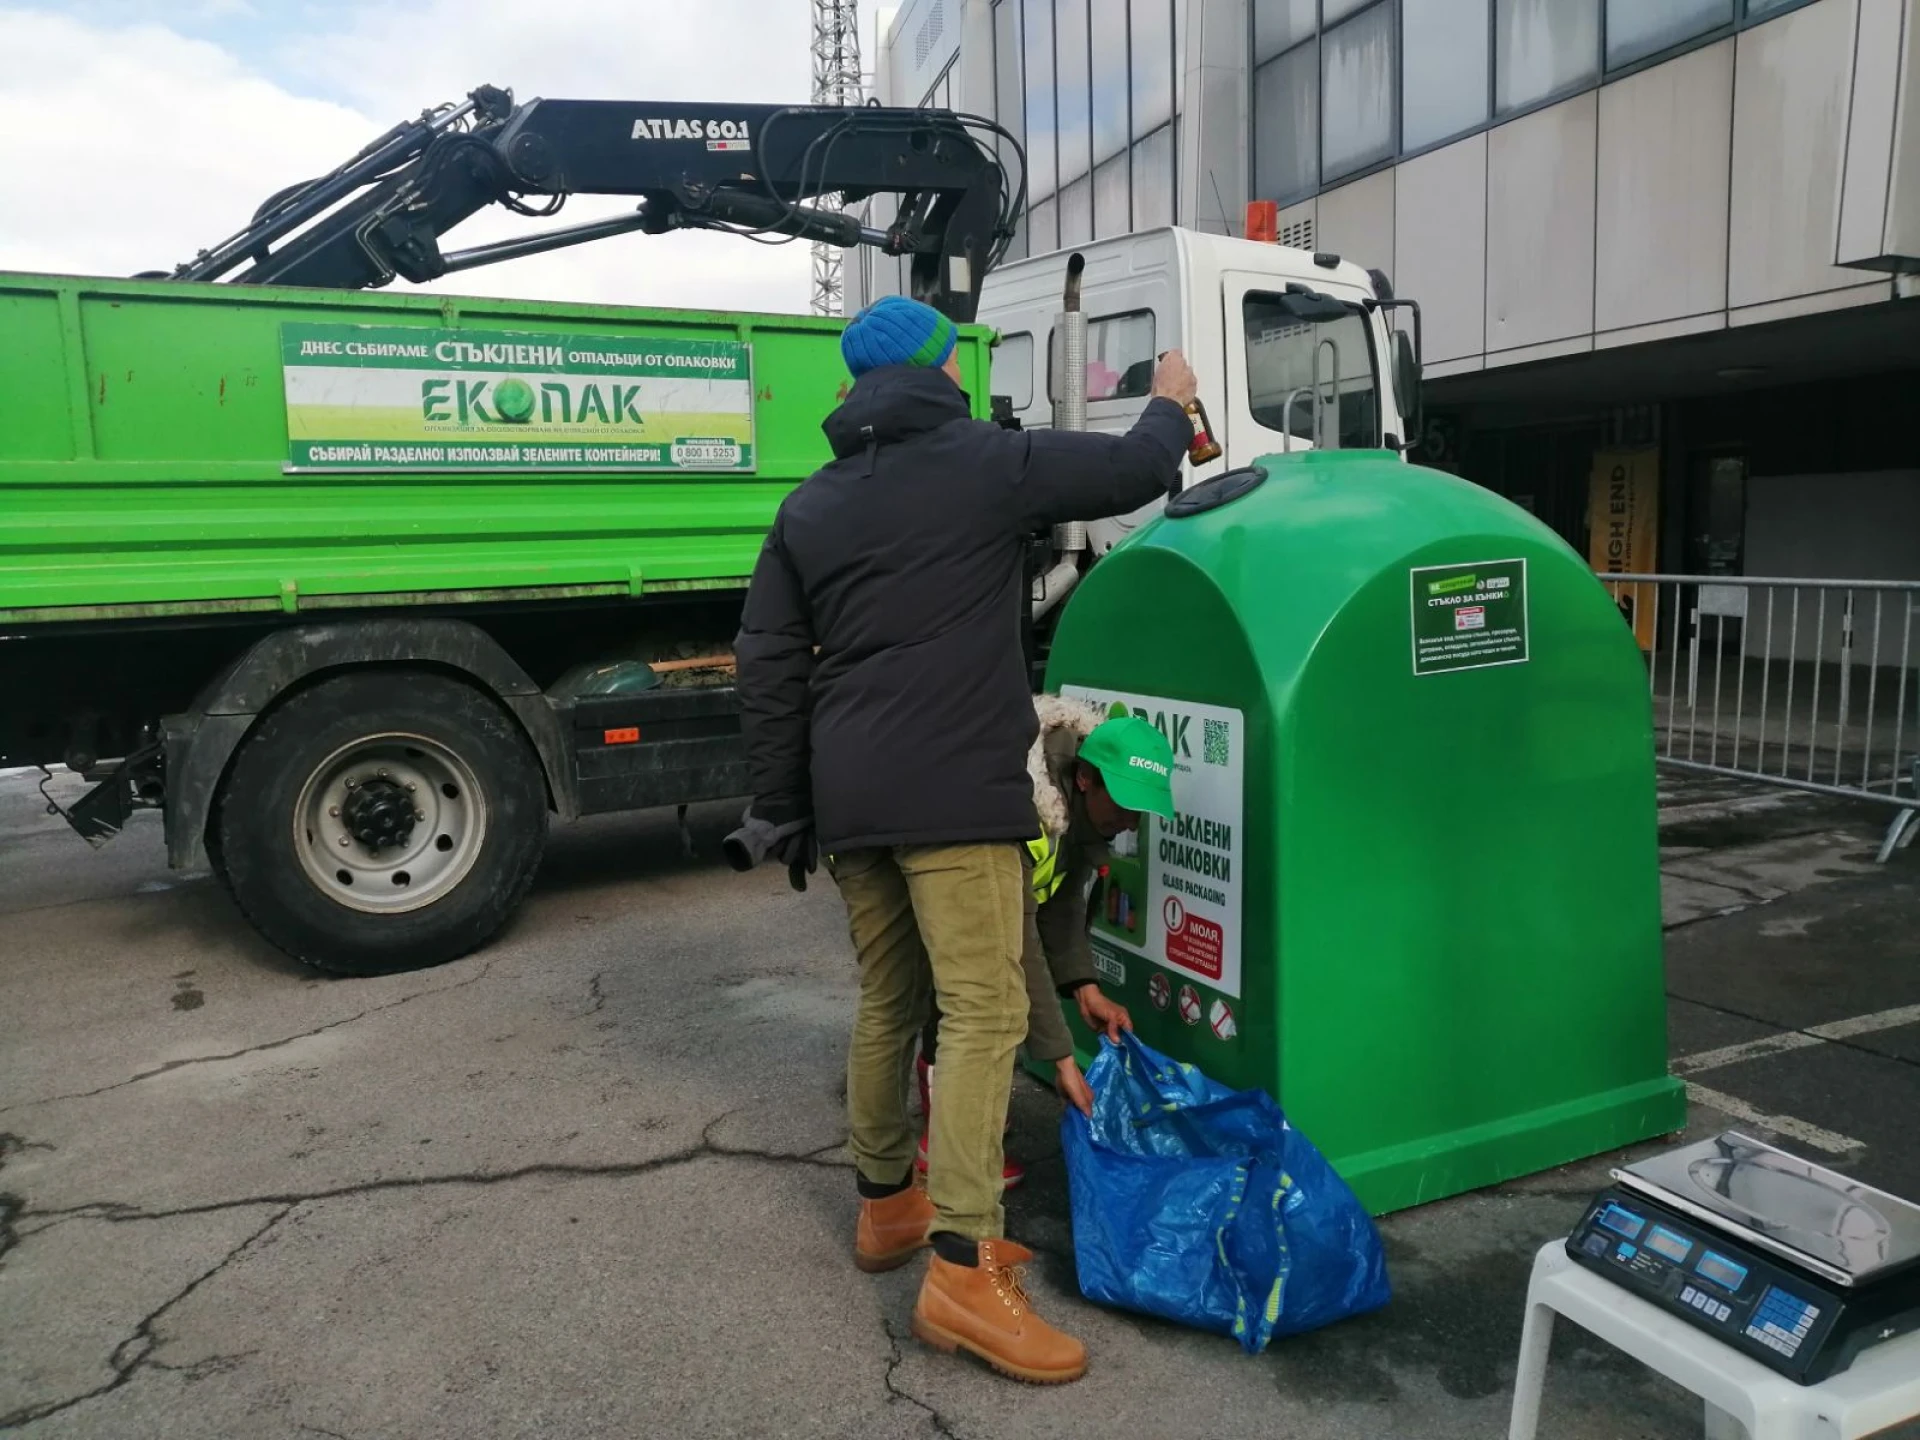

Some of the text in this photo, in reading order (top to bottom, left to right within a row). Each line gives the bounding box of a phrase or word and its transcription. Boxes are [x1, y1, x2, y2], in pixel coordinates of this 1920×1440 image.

[631, 119, 749, 139] ATLAS 60.1
[301, 341, 737, 369] ДНЕС СЪБИРАМЕ СТЪКЛЕНИ ОТПАДЪЦИ ОТ ОПАКОВКИ
[422, 378, 644, 425] ЕКОПАК
[309, 444, 661, 463] СЪБИРАЙ РАЗДЕЛНО! ИЗПОЛЗВАЙ ЗЕЛЕНИТЕ КОНТЕЙНЕРИ!
[677, 448, 735, 458] 0 800 1 5253
[1609, 464, 1626, 514] END
[1427, 595, 1462, 607] СТЪКЛО
[1463, 594, 1474, 603] ЗА
[1159, 811, 1231, 852] СТЪКЛЕНИ
[1159, 838, 1231, 883] ОПАКОВКИ
[1163, 873, 1226, 907] GLASS PACKAGING
